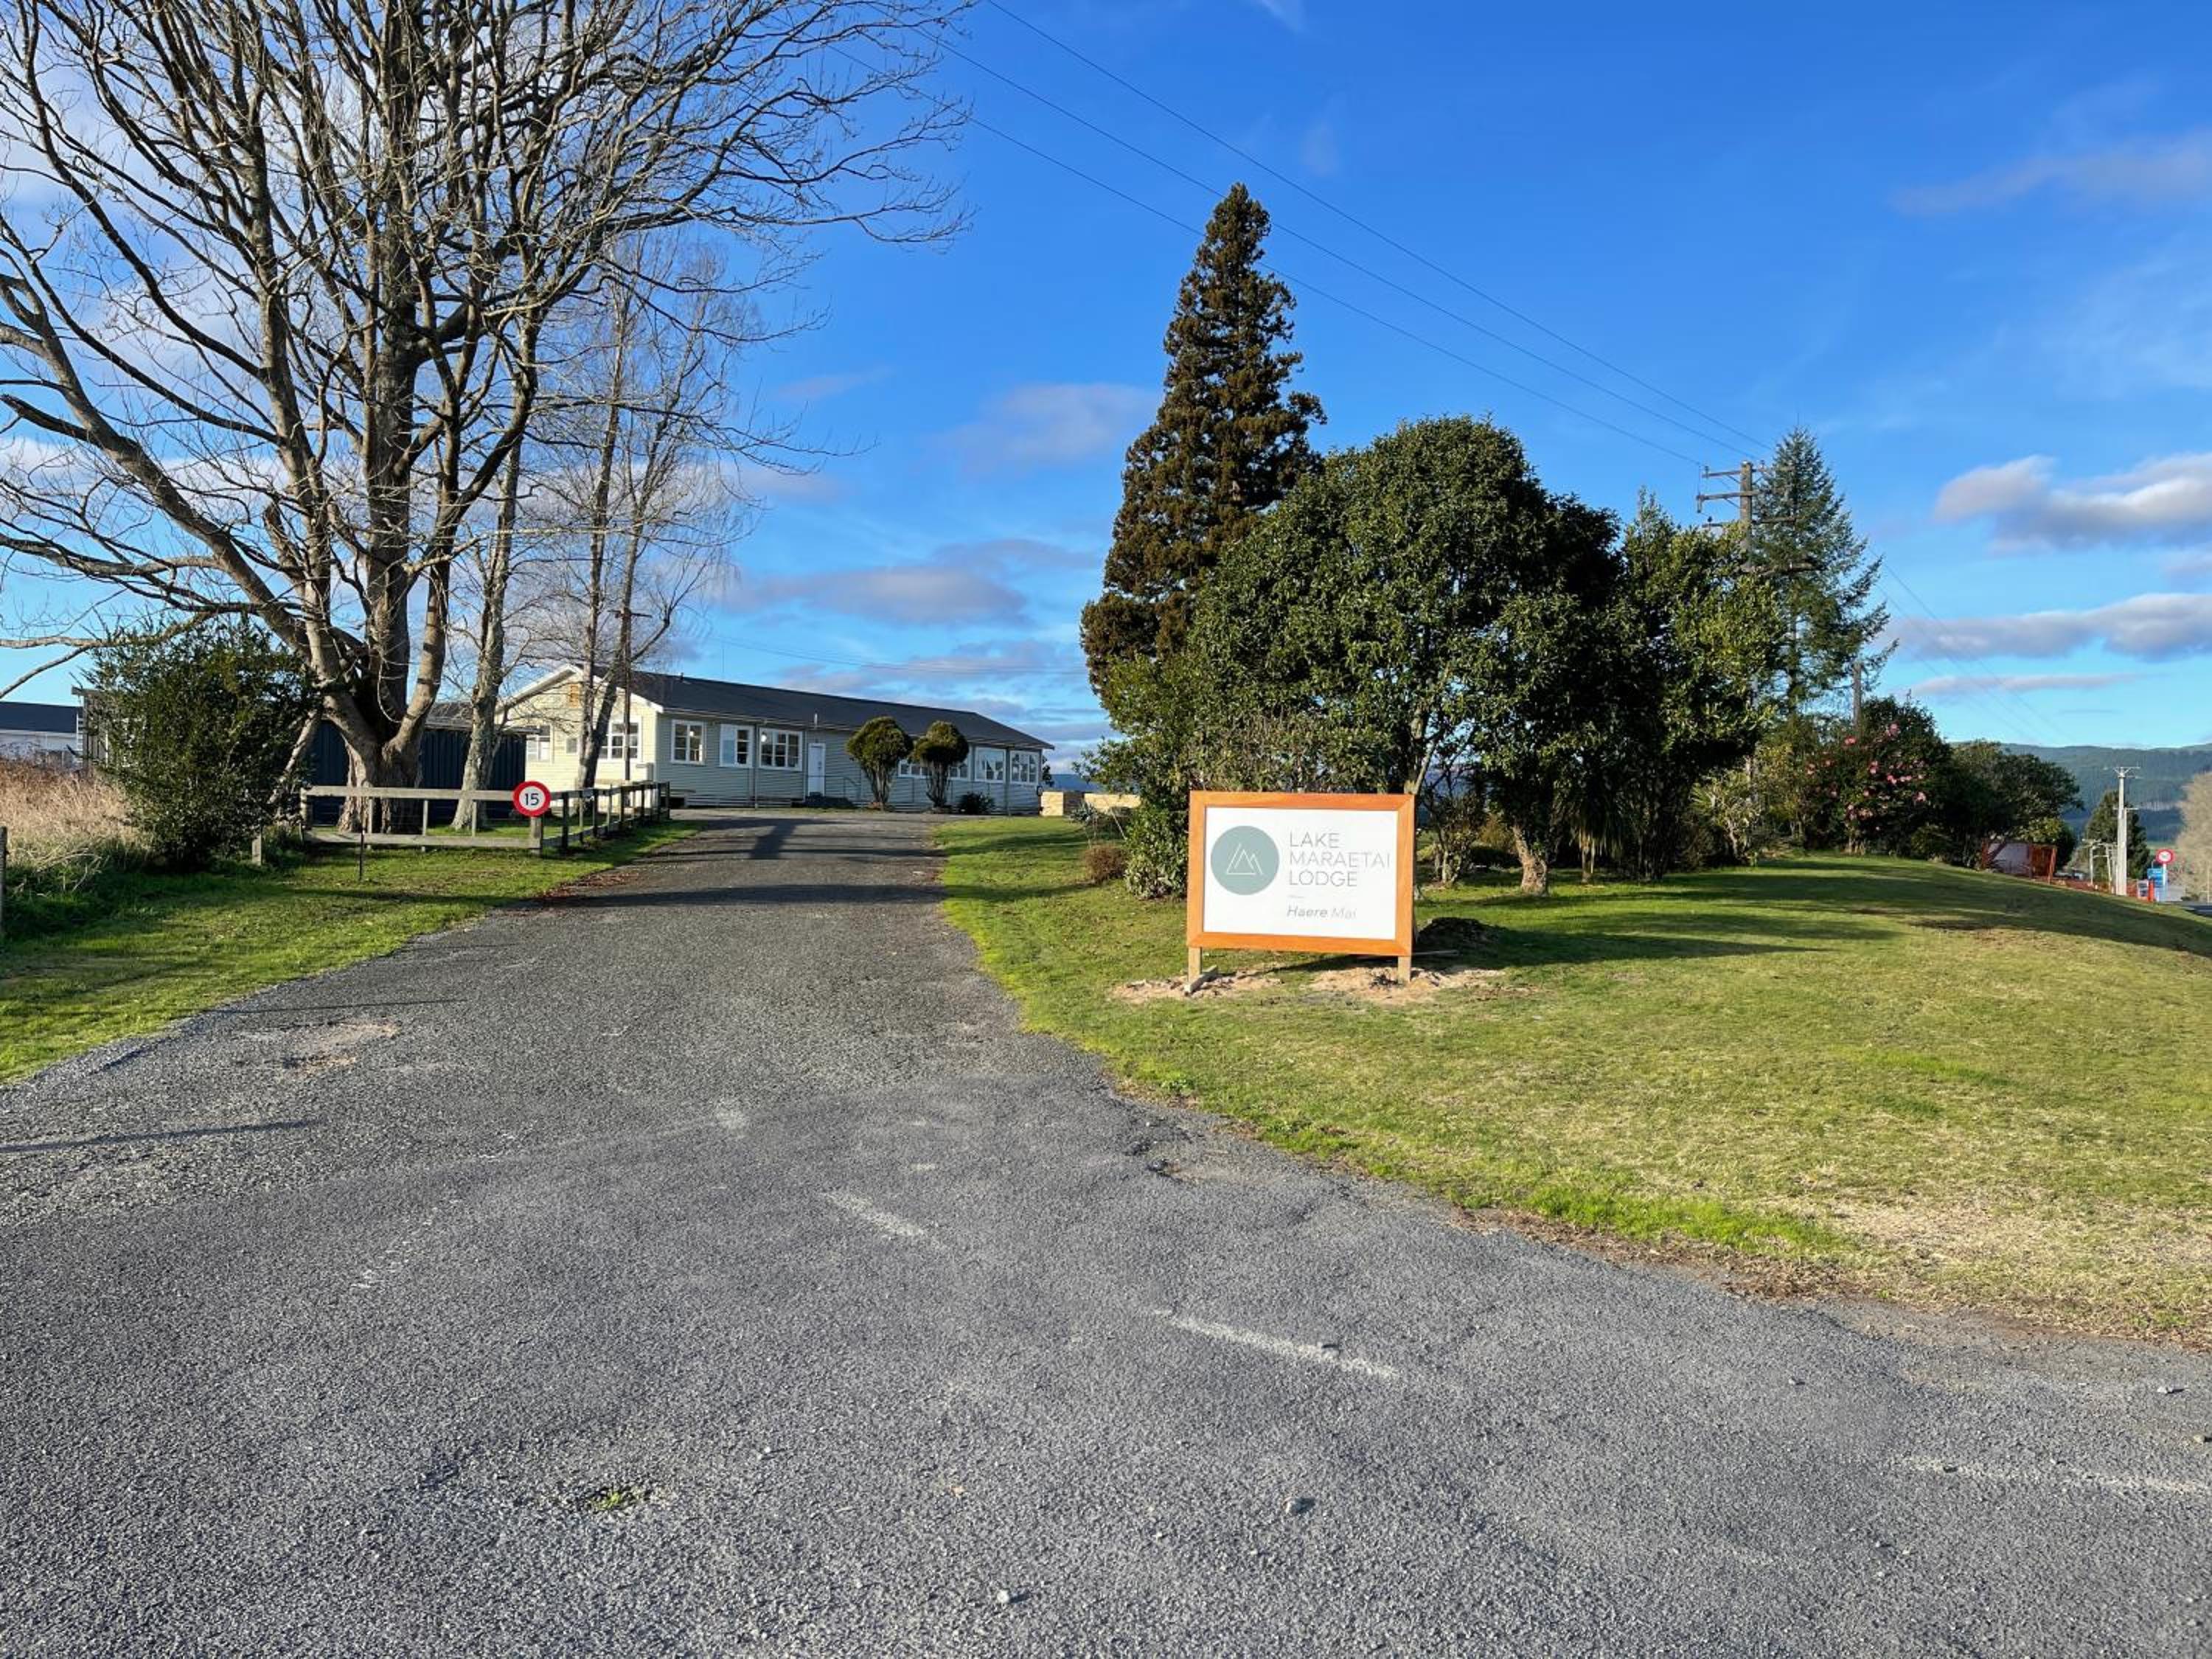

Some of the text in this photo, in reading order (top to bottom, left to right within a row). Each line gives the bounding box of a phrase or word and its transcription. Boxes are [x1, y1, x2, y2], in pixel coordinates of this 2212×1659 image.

[524, 793, 540, 806] 15
[1290, 831, 1340, 849] LAKE
[1290, 850, 1391, 869] MARAETAI
[1289, 869, 1357, 887] LODGE
[1286, 905, 1357, 919] Haere Mai
